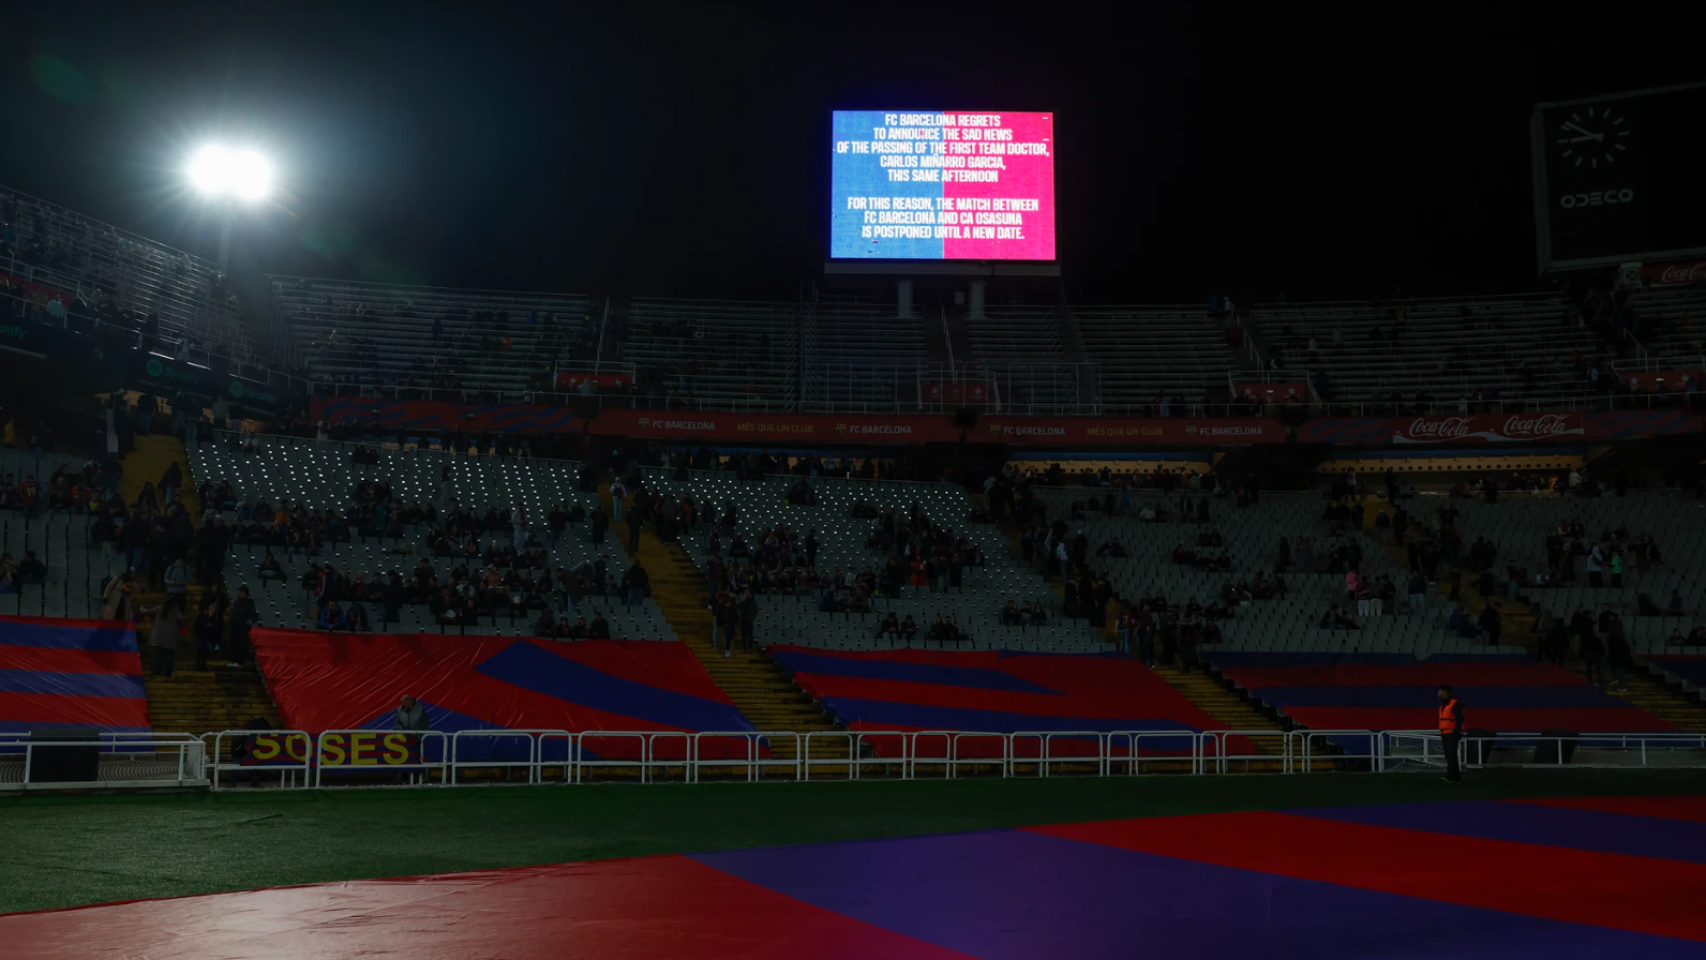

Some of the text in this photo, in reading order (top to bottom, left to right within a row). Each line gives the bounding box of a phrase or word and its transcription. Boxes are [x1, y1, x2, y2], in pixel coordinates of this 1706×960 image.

[886, 114, 1000, 126] FC BARCELONA REGRETS
[874, 128, 1012, 140] TO ANNOUNCE THE SAD NEWS
[837, 141, 1049, 157] OF THE PASSING OF THE FIRST TEAM DOCTOR,
[881, 153, 1005, 171] CARLOS MIÑARRO GARCIA,
[888, 169, 998, 182] THIS SAME AFTERNOON
[848, 197, 1038, 211] FOR THIS REASON, THE MATCH BETWEEN
[1560, 188, 1634, 209] ODECO
[865, 211, 1022, 224] FC BARCELONA AND CA OSASUNA
[862, 226, 1024, 239] IS POSTPONED UNTIL A NEW DATE.
[164, 365, 198, 388] Spotify
[245, 387, 275, 405] Spotify
[652, 420, 716, 430] FC BARCELONA
[736, 421, 814, 434] MÉS QUE UN CLUB
[850, 425, 912, 434] FC BARCELONA
[1003, 426, 1014, 435] FC
[1087, 425, 1164, 437] MÉS QUE UN CLUB
[1199, 426, 1263, 436] FC BARCELONA
[1409, 417, 1475, 437] Coca-Cola
[1503, 414, 1571, 435] Coca-Cola
